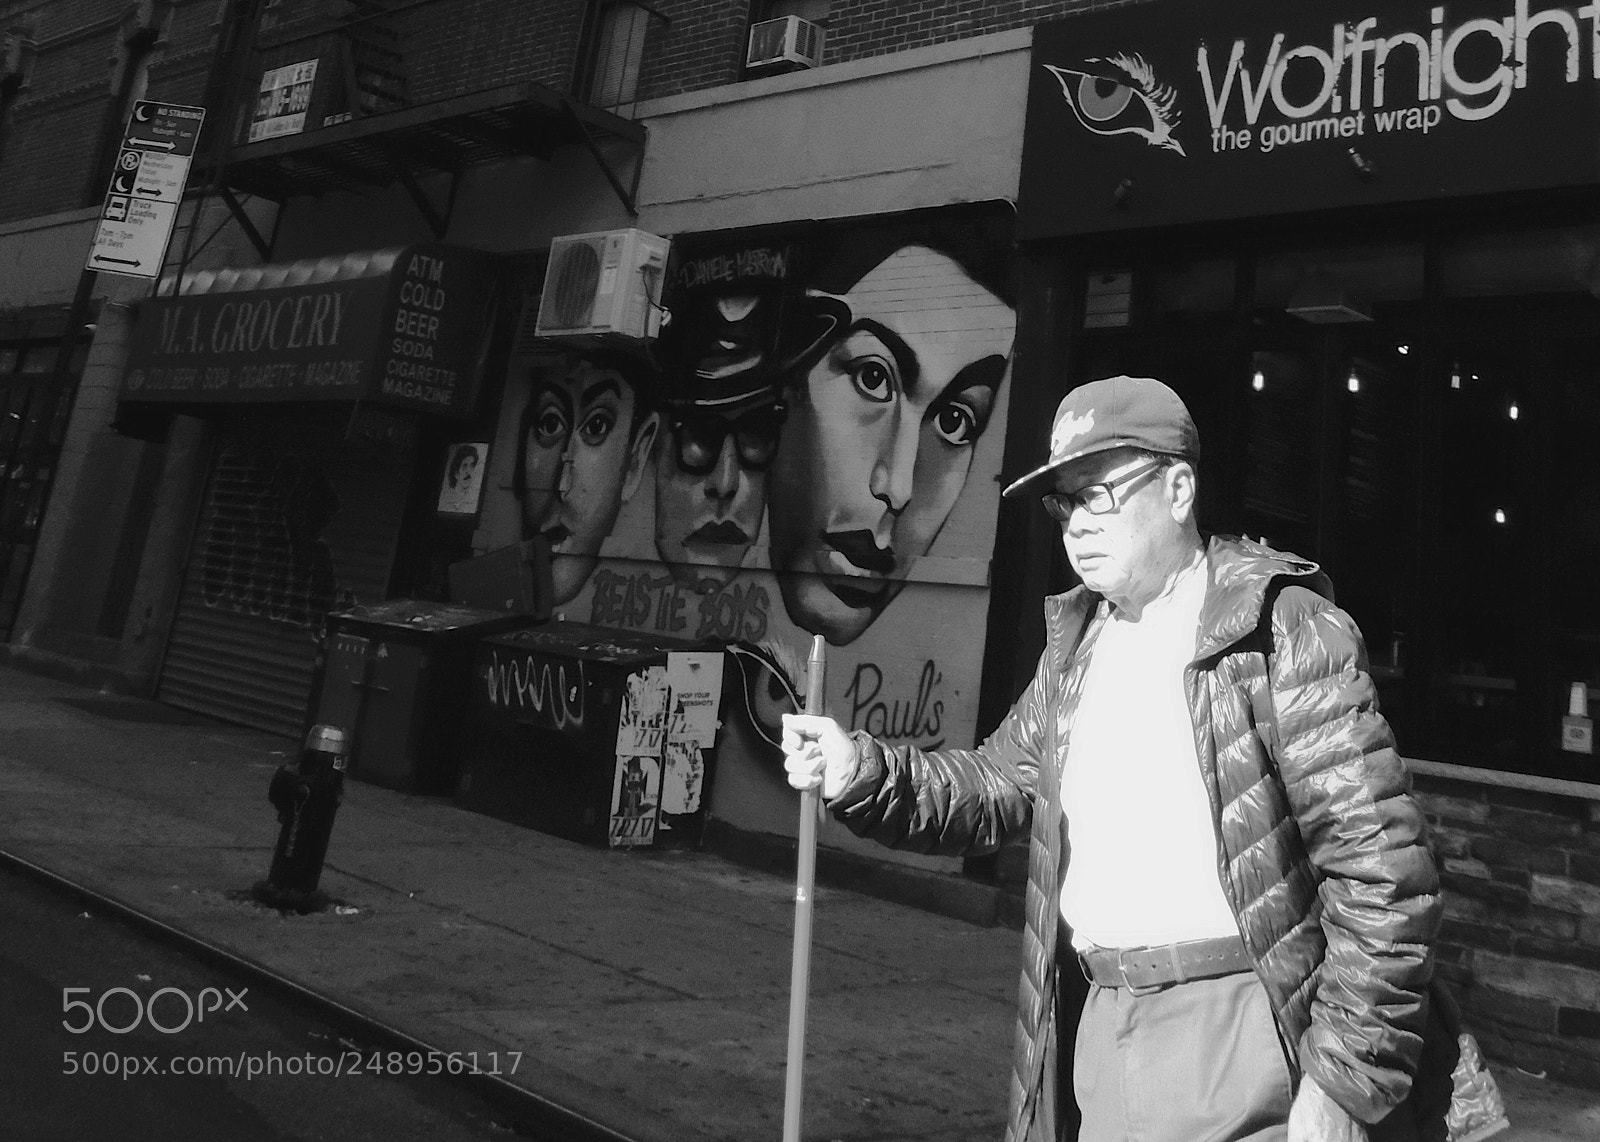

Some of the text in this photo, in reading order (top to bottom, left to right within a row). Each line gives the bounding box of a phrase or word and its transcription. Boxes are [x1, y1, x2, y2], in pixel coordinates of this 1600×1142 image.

[1211, 104, 1441, 153] the gourmet wrap
[130, 208, 157, 220] Loading
[132, 199, 152, 209] Truck
[128, 216, 144, 227] Only
[107, 238, 124, 248] Days
[407, 254, 444, 283] ATM
[400, 281, 445, 311] COLD
[211, 292, 346, 354] GROCERY
[395, 309, 440, 340] BEER
[392, 338, 433, 360] SODA
[238, 363, 298, 388] CIGARETTE
[303, 359, 363, 386] MAGAZINE
[387, 359, 456, 387] CIGARETTE
[383, 376, 452, 405] MAGAZINE
[695, 577, 769, 643] BOYS
[844, 659, 944, 738] Paul's
